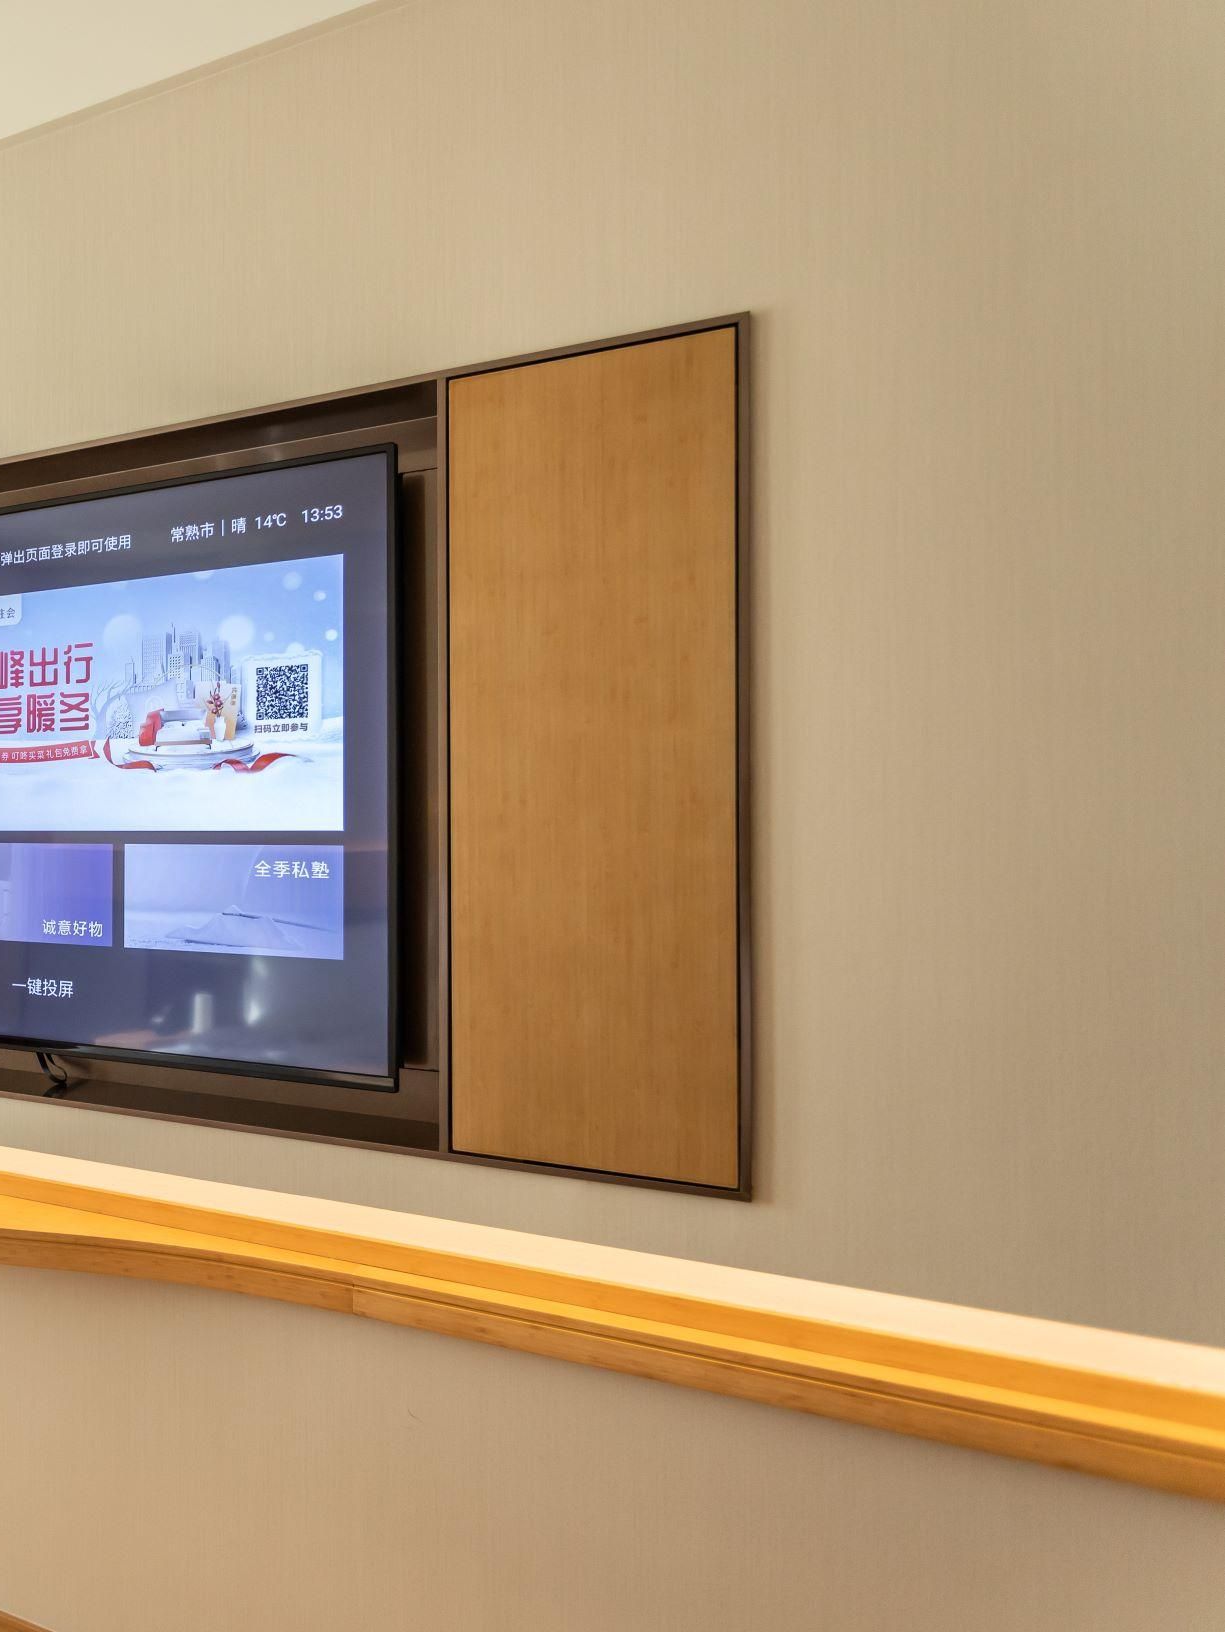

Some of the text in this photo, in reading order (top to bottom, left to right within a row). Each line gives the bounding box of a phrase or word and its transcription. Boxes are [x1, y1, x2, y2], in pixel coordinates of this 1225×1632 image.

[170, 521, 215, 543] 常熟市
[231, 517, 247, 535] 晴
[301, 504, 344, 524] 13:53
[254, 722, 309, 734] 扫码立即参与
[254, 860, 330, 879] 全季私塾
[42, 919, 103, 938] 诚意好物
[11, 977, 74, 998] 一键投屏
